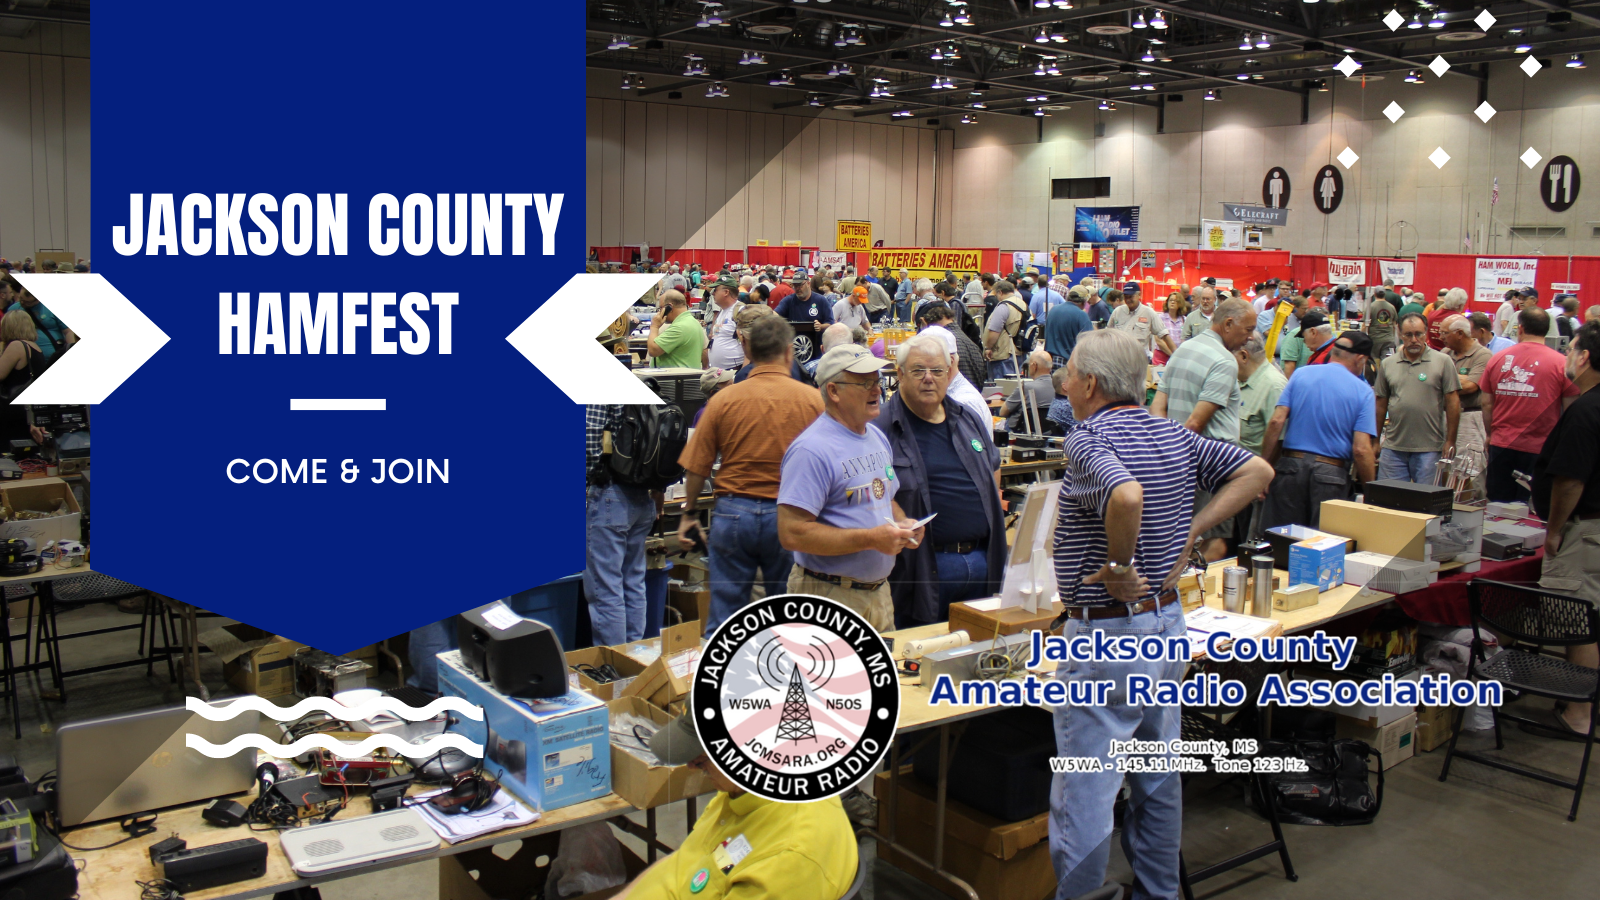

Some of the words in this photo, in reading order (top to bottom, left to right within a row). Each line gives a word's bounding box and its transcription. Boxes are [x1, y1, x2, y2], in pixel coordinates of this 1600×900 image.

[840, 224, 870, 237] BATTERIES
[843, 237, 867, 249] AMERICA
[871, 252, 927, 268] BATTERIES
[929, 253, 979, 270] AMERICA
[1478, 261, 1494, 270] HAM
[1495, 261, 1521, 271] WORLD,
[1329, 260, 1362, 277] hy-gain
[1497, 277, 1513, 285] MFJ
[555, 731, 585, 743] SATELLITE
[585, 726, 604, 735] RADIO
